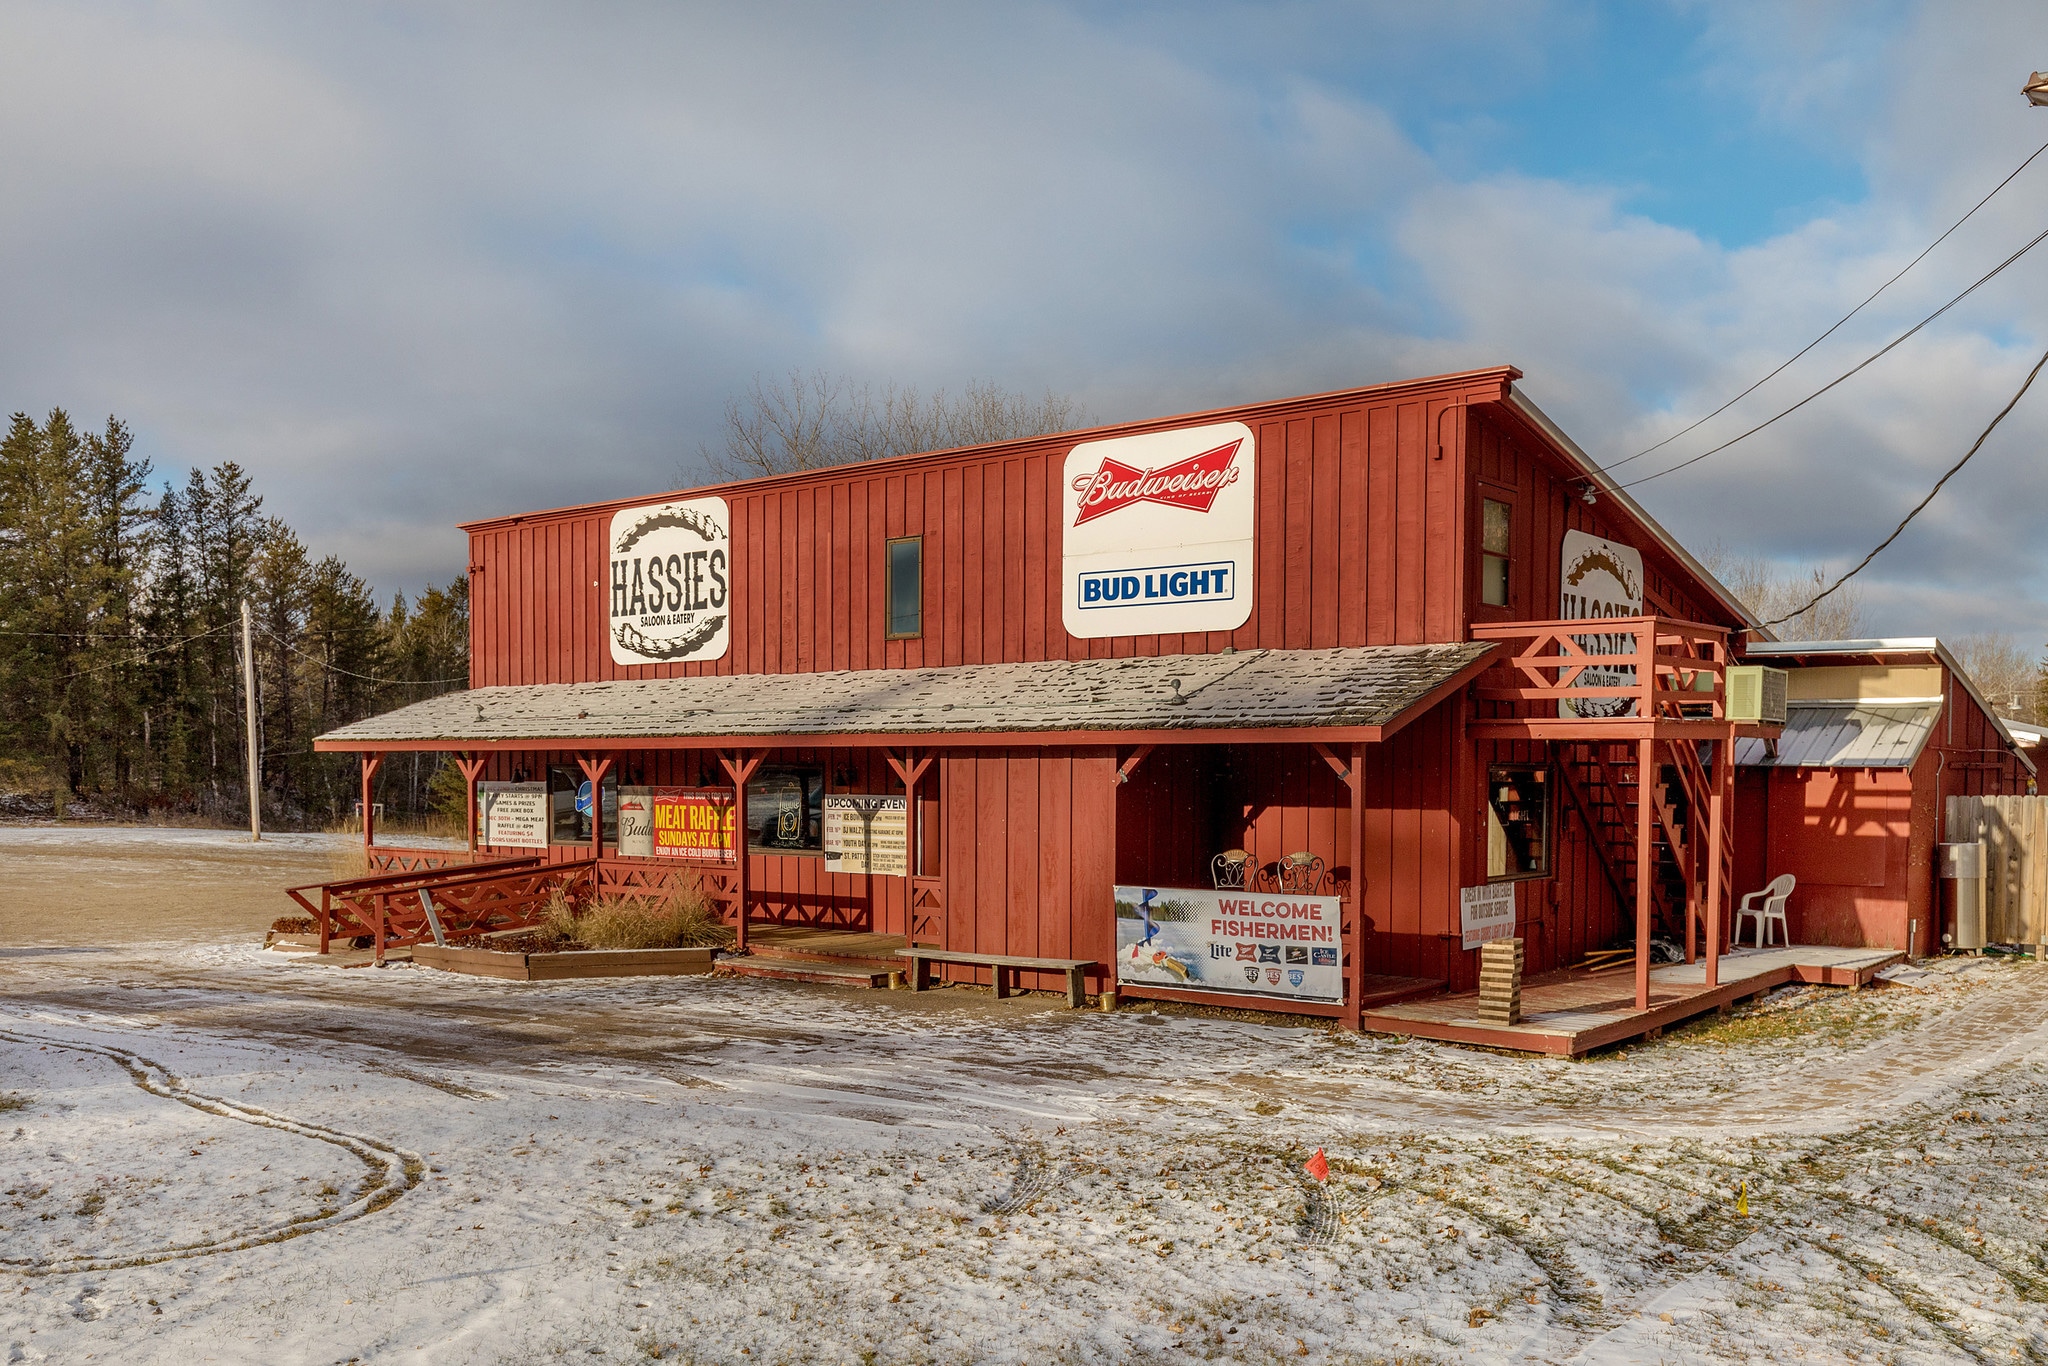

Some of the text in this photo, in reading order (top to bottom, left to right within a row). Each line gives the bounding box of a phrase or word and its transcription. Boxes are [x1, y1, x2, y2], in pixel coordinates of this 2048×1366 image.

[1072, 463, 1240, 508] Budweiser
[612, 549, 727, 617] HASSIES
[1084, 569, 1228, 602] BUD LIGHT
[641, 612, 696, 627] SALOON & EATERY
[1584, 672, 1601, 686] SALOON
[1606, 674, 1621, 687] EATERY
[827, 798, 878, 809] UPCOMING
[655, 805, 736, 830] MEAT RAFFLE
[658, 831, 730, 848] SUNDAYS AT 4PM
[656, 846, 671, 855] ENJOY
[672, 847, 678, 856] AN
[688, 848, 701, 857] COLD
[1218, 899, 1322, 920] WELCOME
[1211, 920, 1333, 942] FISHERMEN!
[1210, 943, 1232, 960] Lite
